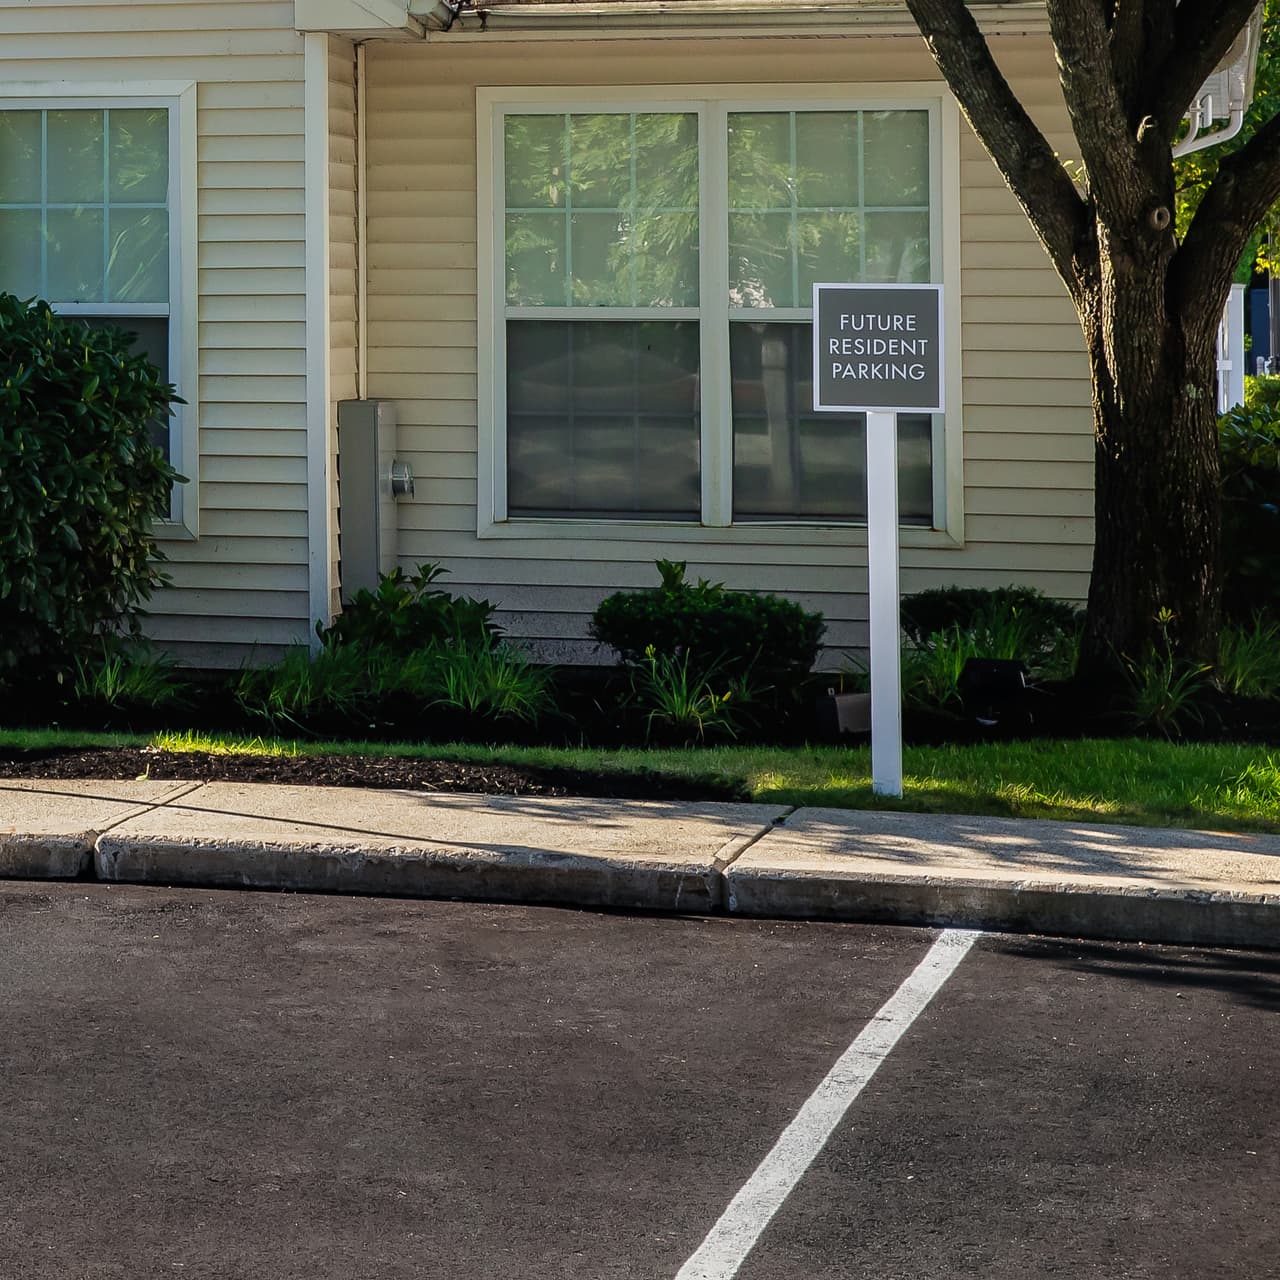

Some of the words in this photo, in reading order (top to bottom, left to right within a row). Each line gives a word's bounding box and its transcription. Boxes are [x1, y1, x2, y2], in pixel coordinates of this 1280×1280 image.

[840, 314, 917, 332] FUTURE
[829, 338, 929, 357] RESIDENT
[832, 363, 926, 381] PARKING
